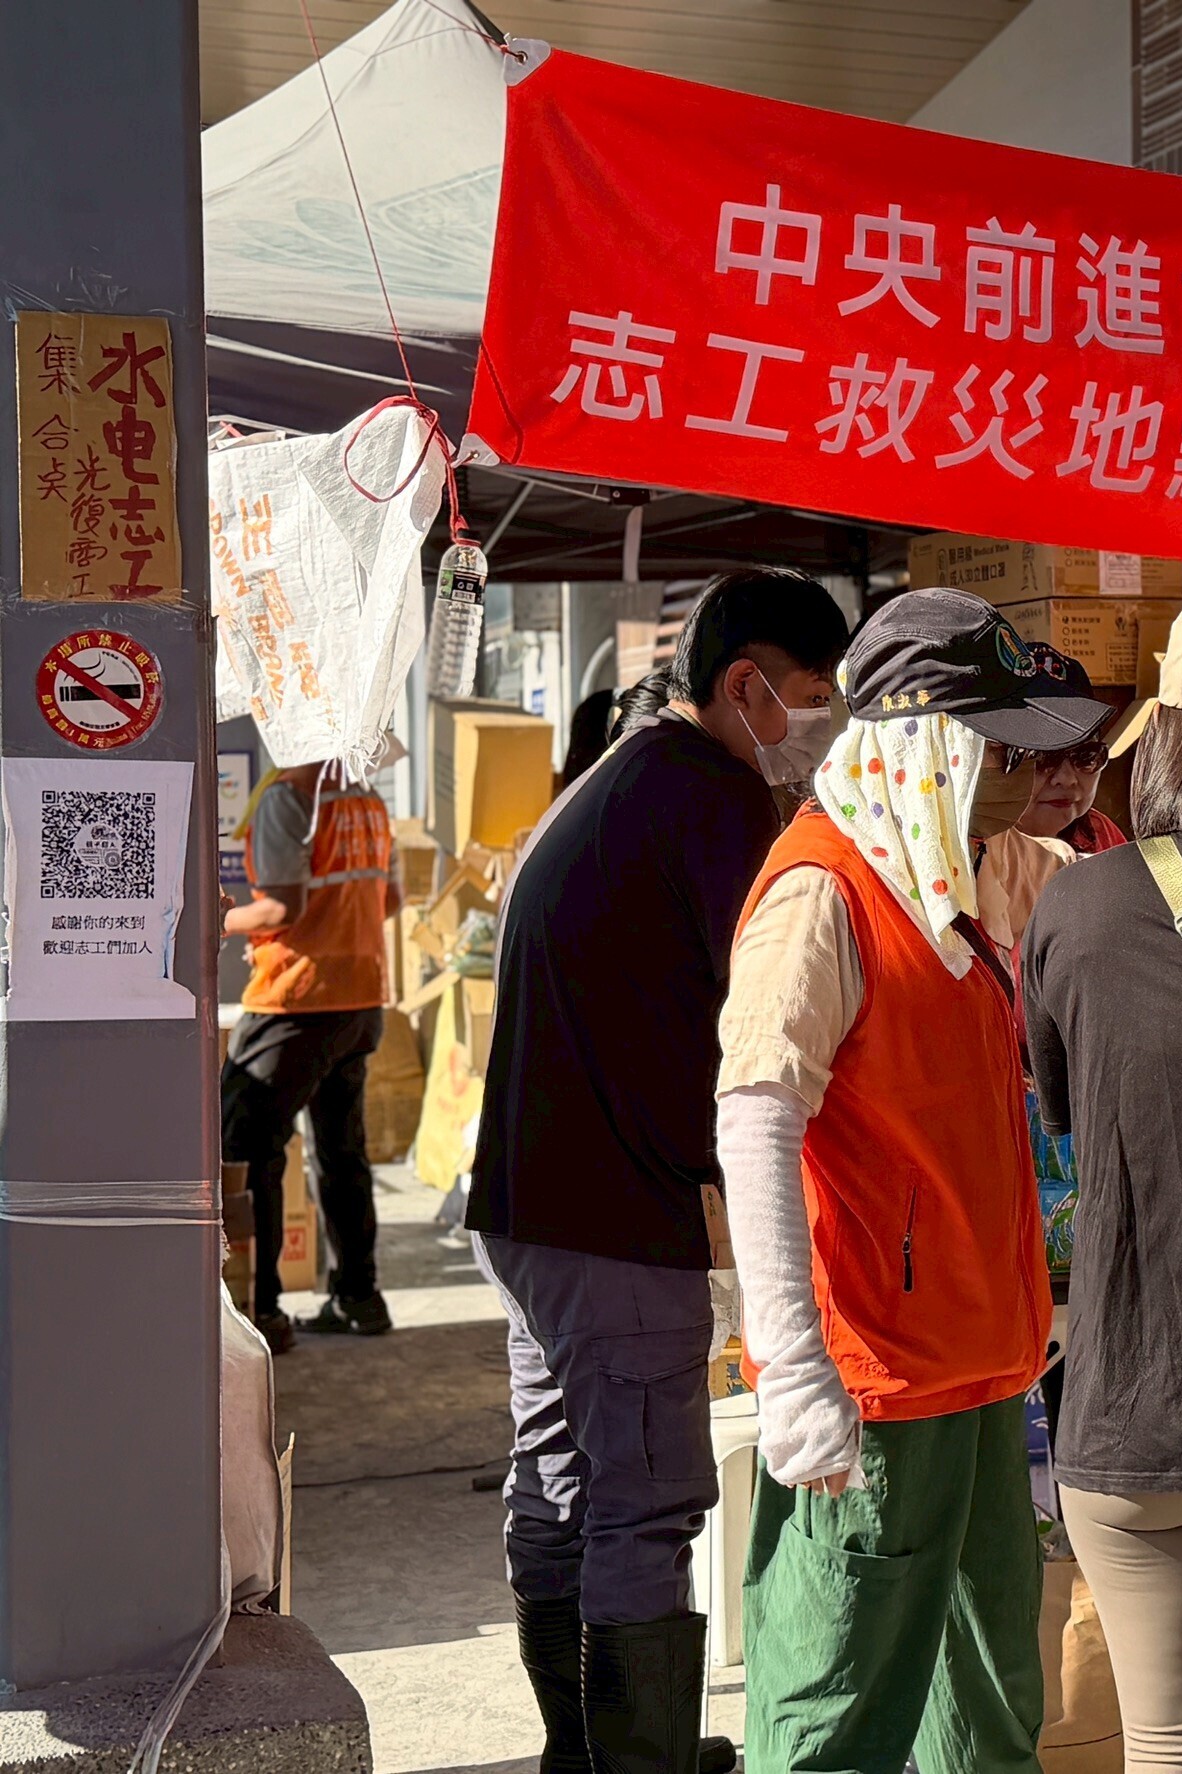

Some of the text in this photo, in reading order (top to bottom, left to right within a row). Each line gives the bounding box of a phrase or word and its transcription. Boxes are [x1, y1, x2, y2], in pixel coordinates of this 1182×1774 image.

[51, 915, 146, 930] 感謝你的來到
